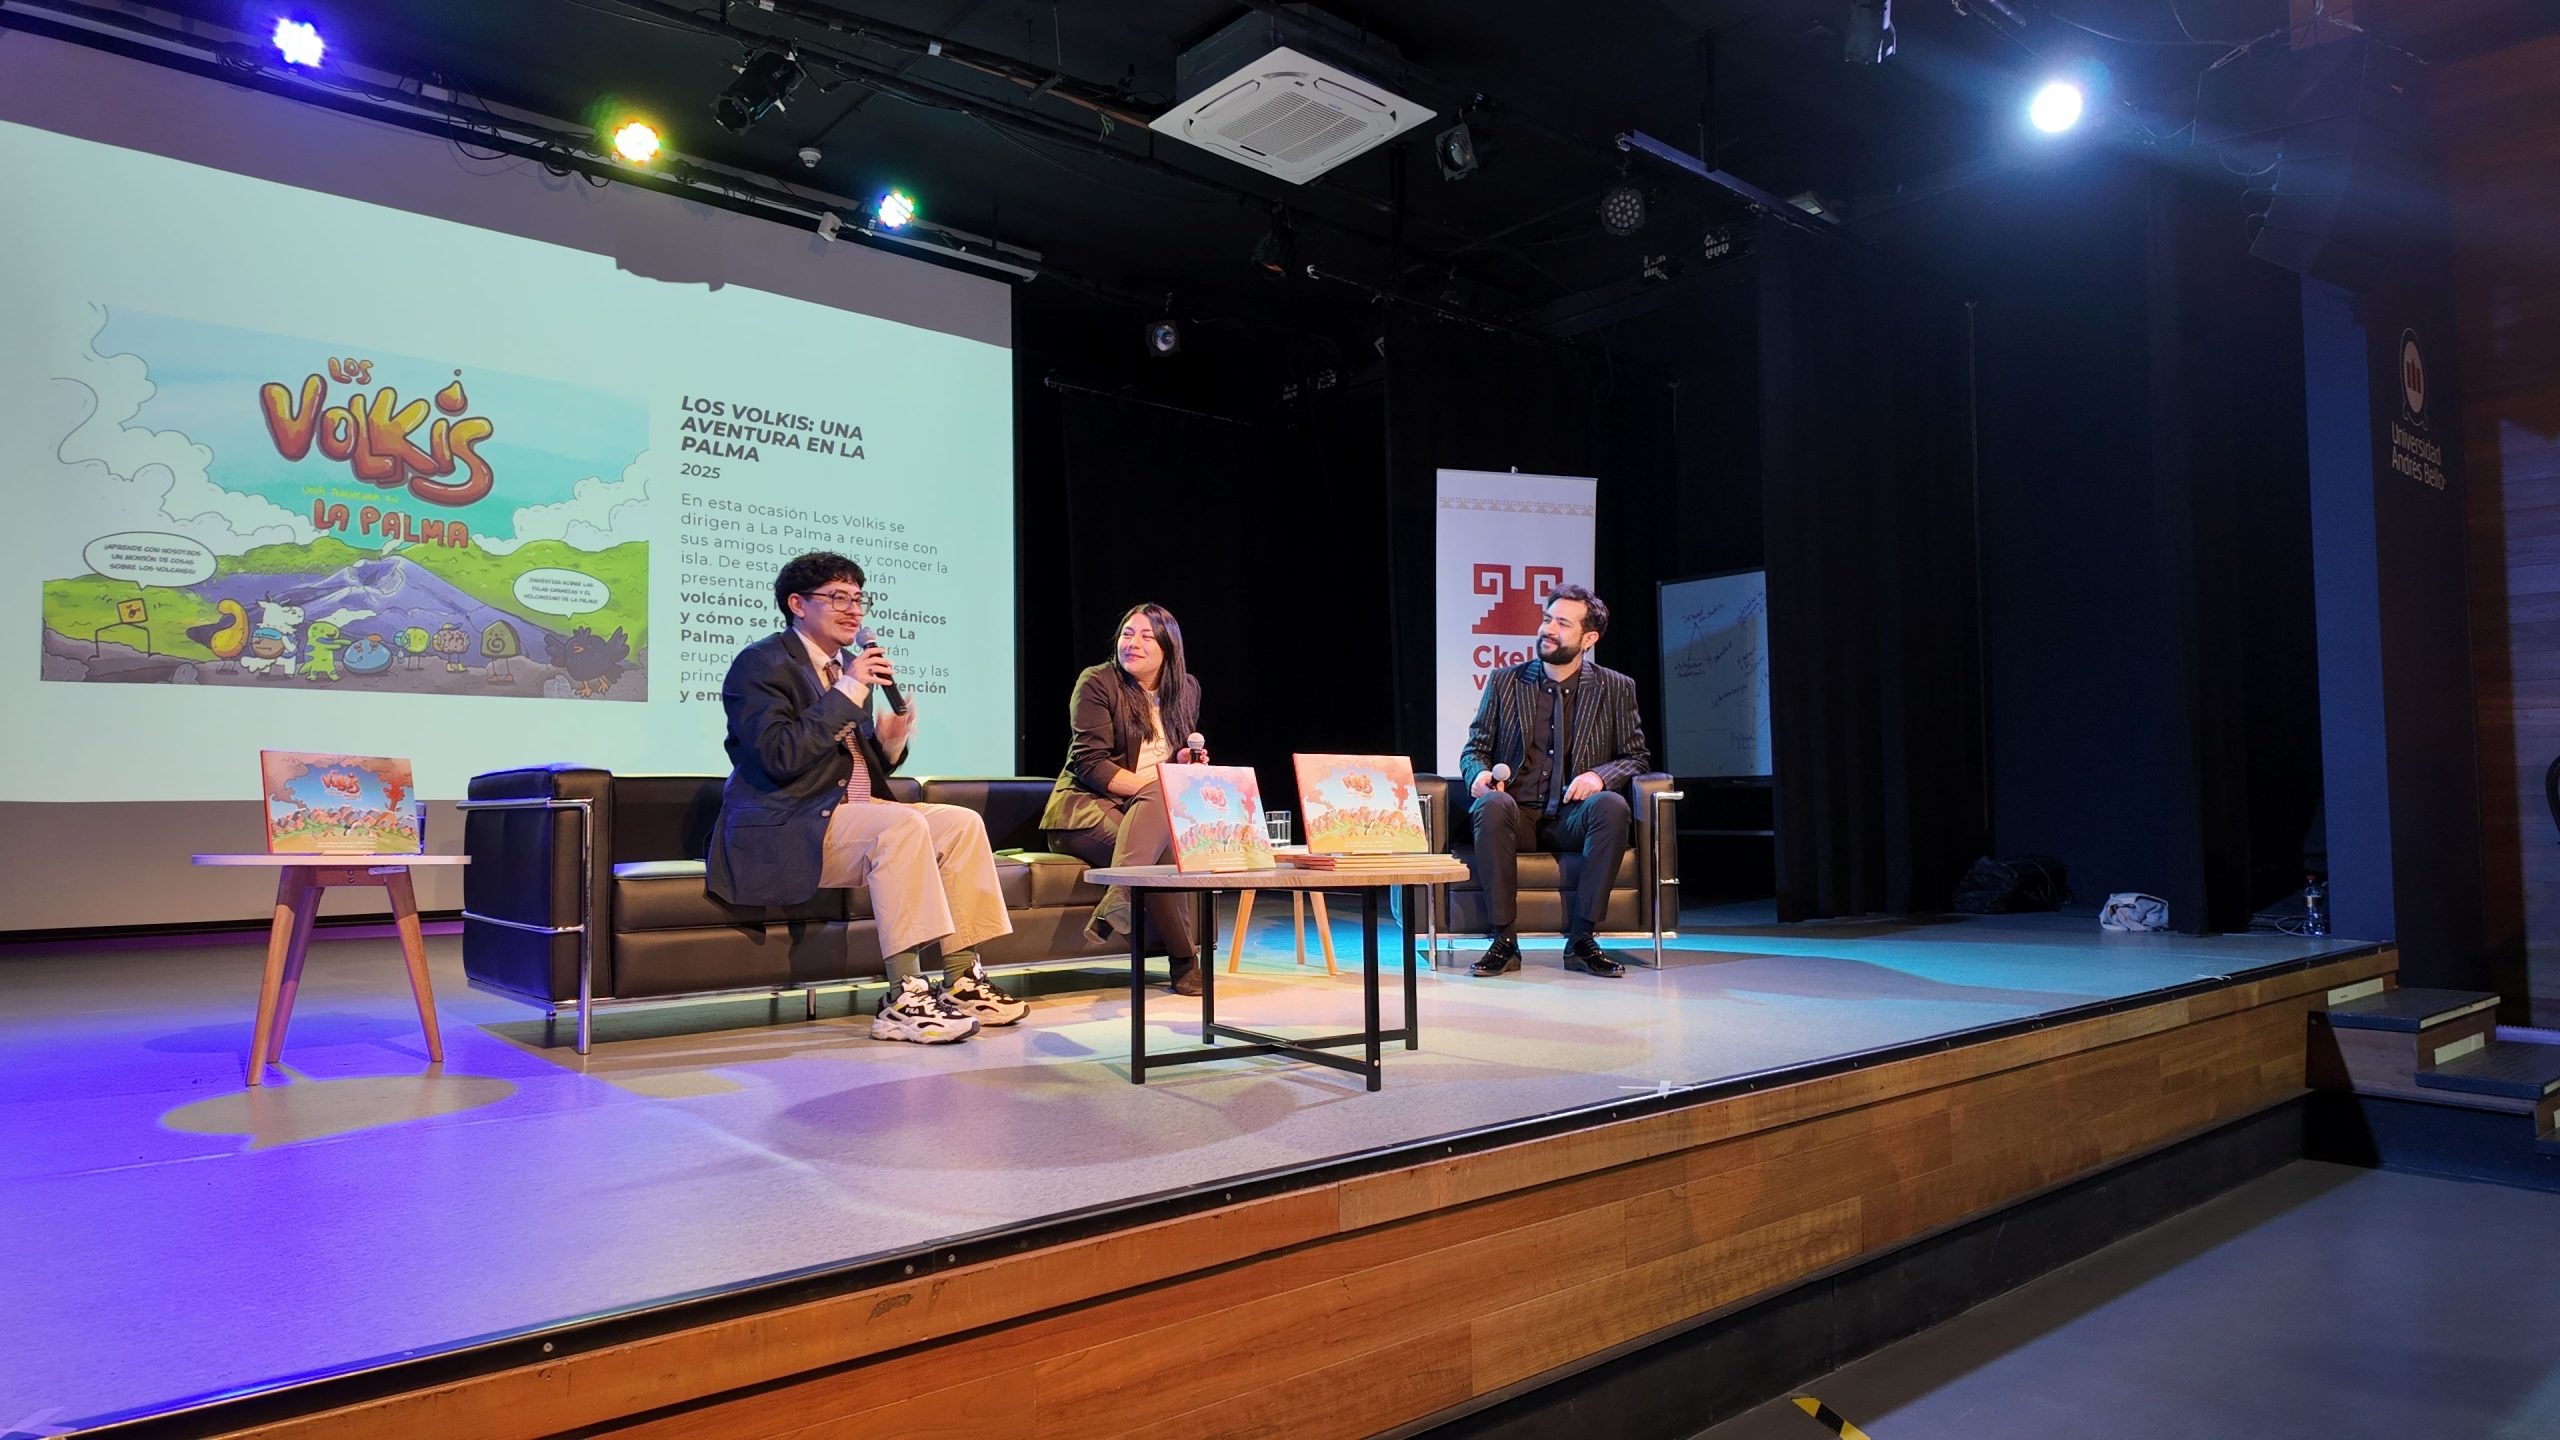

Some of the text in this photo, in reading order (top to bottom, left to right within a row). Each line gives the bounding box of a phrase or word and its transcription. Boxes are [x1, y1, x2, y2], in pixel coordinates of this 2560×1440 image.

[328, 357, 374, 385] LOS
[681, 395, 863, 441] LOS VOLKIS: UNA
[680, 416, 865, 460] AVENTURA EN LA
[681, 436, 760, 462] PALMA
[2391, 421, 2442, 466] Universidad
[680, 463, 721, 479] 2025
[2391, 446, 2446, 491] Andrés Bello
[313, 498, 469, 549] LA PALMA
[681, 492, 905, 533] En esta ocasión Los Volkis se
[680, 512, 938, 555] dirigen a La Palma a reunirse con
[680, 534, 709, 547] sus
[714, 538, 774, 555] amigos
[780, 543, 805, 556] Los
[864, 555, 873, 567] y
[876, 556, 933, 572] conocer
[937, 561, 948, 574] la
[681, 550, 779, 573] isla. De esta
[681, 570, 896, 591] presentand irán
[680, 592, 768, 611] volcánico,
[680, 612, 690, 625] y
[696, 611, 744, 626] cómo
[750, 617, 768, 628] se
[876, 626, 895, 638] de
[899, 627, 916, 640] La
[870, 608, 947, 625] volcánicos
[681, 629, 739, 646] Palma.
[680, 651, 734, 666] erupci
[1472, 645, 1534, 669] Ckel
[919, 666, 927, 678] y
[931, 664, 949, 677] las
[680, 690, 690, 703] y
